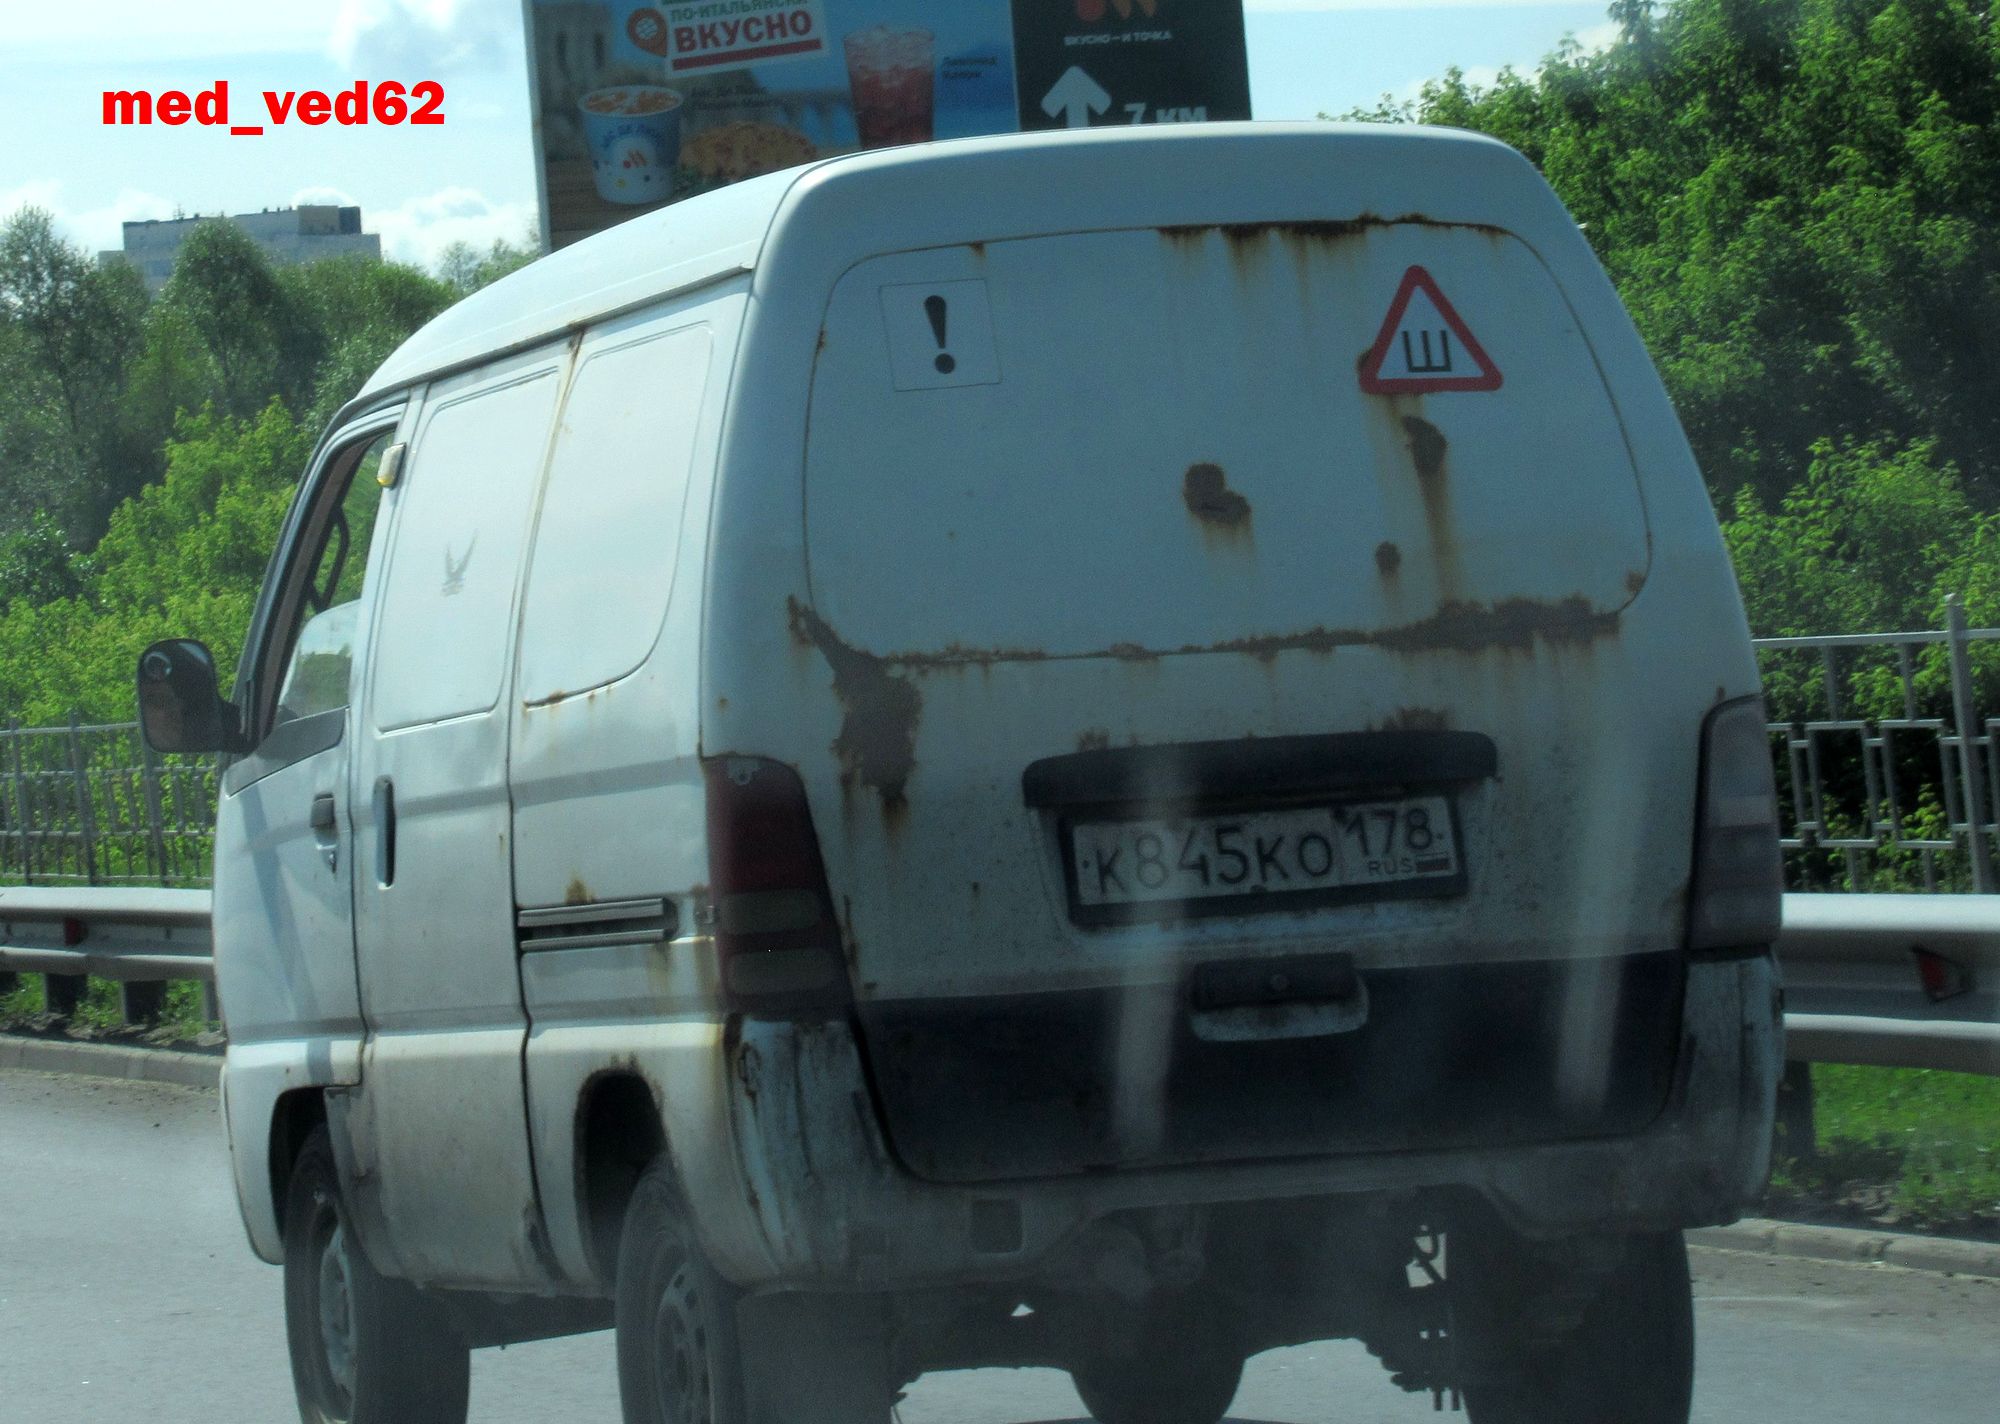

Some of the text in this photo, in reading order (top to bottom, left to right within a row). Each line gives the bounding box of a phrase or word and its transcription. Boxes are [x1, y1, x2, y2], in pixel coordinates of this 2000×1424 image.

[673, 10, 812, 52] ВКУСНО
[1124, 103, 1147, 124] 7
[1401, 329, 1452, 372] Ш
[1097, 807, 1433, 895] К845КО 178
[1367, 856, 1413, 875] RUS
